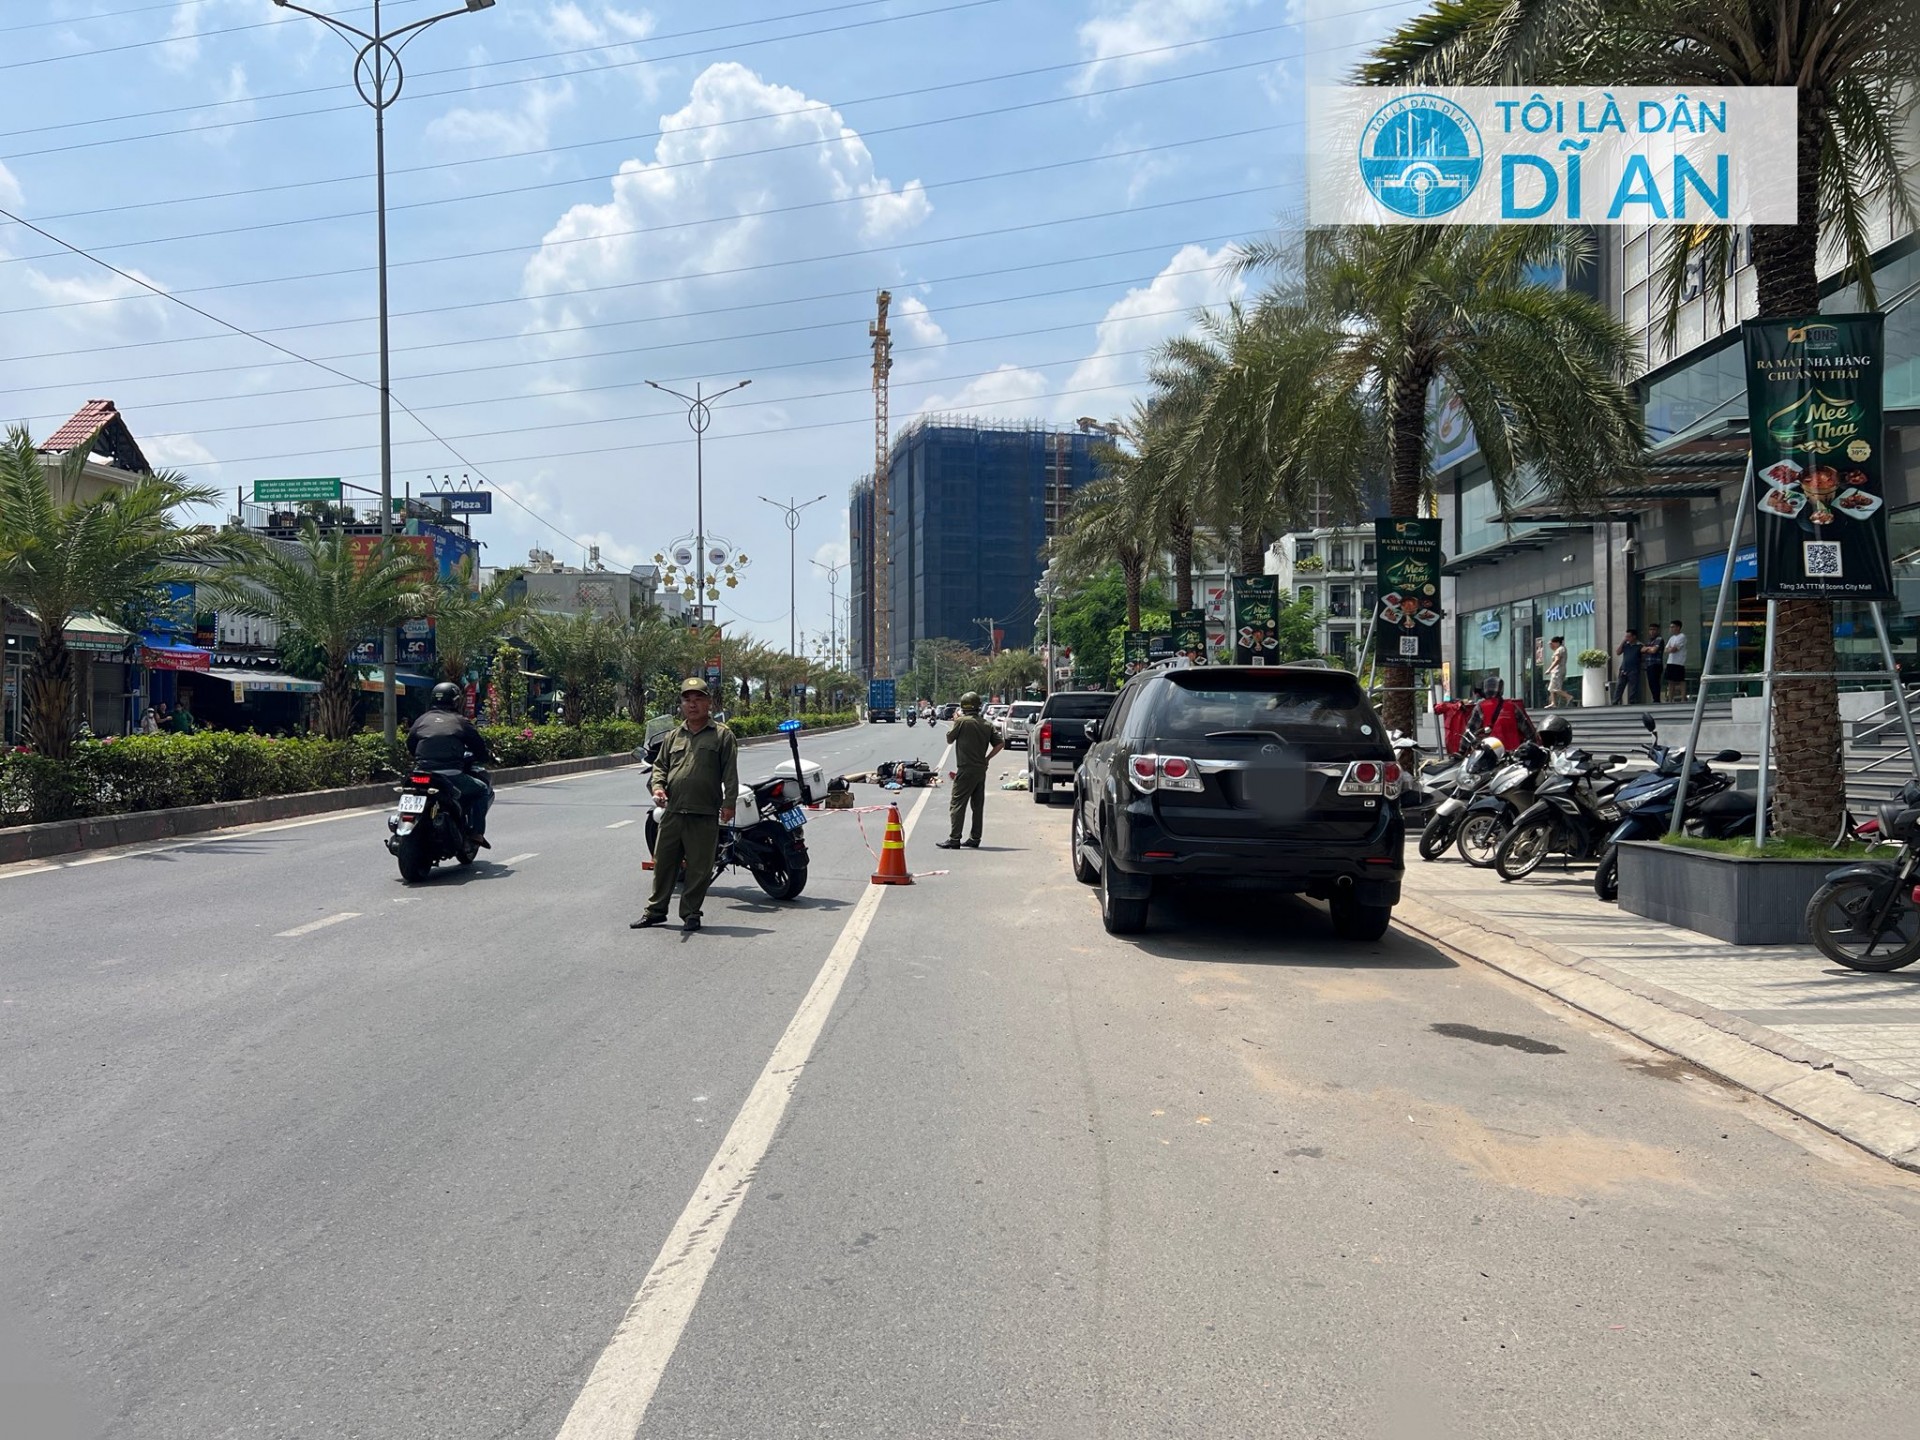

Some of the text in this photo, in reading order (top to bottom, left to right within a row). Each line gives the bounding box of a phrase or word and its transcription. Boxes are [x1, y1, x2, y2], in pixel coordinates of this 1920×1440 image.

[1757, 360, 1773, 369] RA
[1807, 355, 1831, 367] NHÀ
[1835, 353, 1871, 366] HÀNG
[1813, 371, 1826, 381] VỊ
[1829, 367, 1859, 380] THÁI
[1804, 403, 1848, 424] Mee
[1813, 422, 1859, 439] Thai
[1403, 564, 1425, 575] Mee
